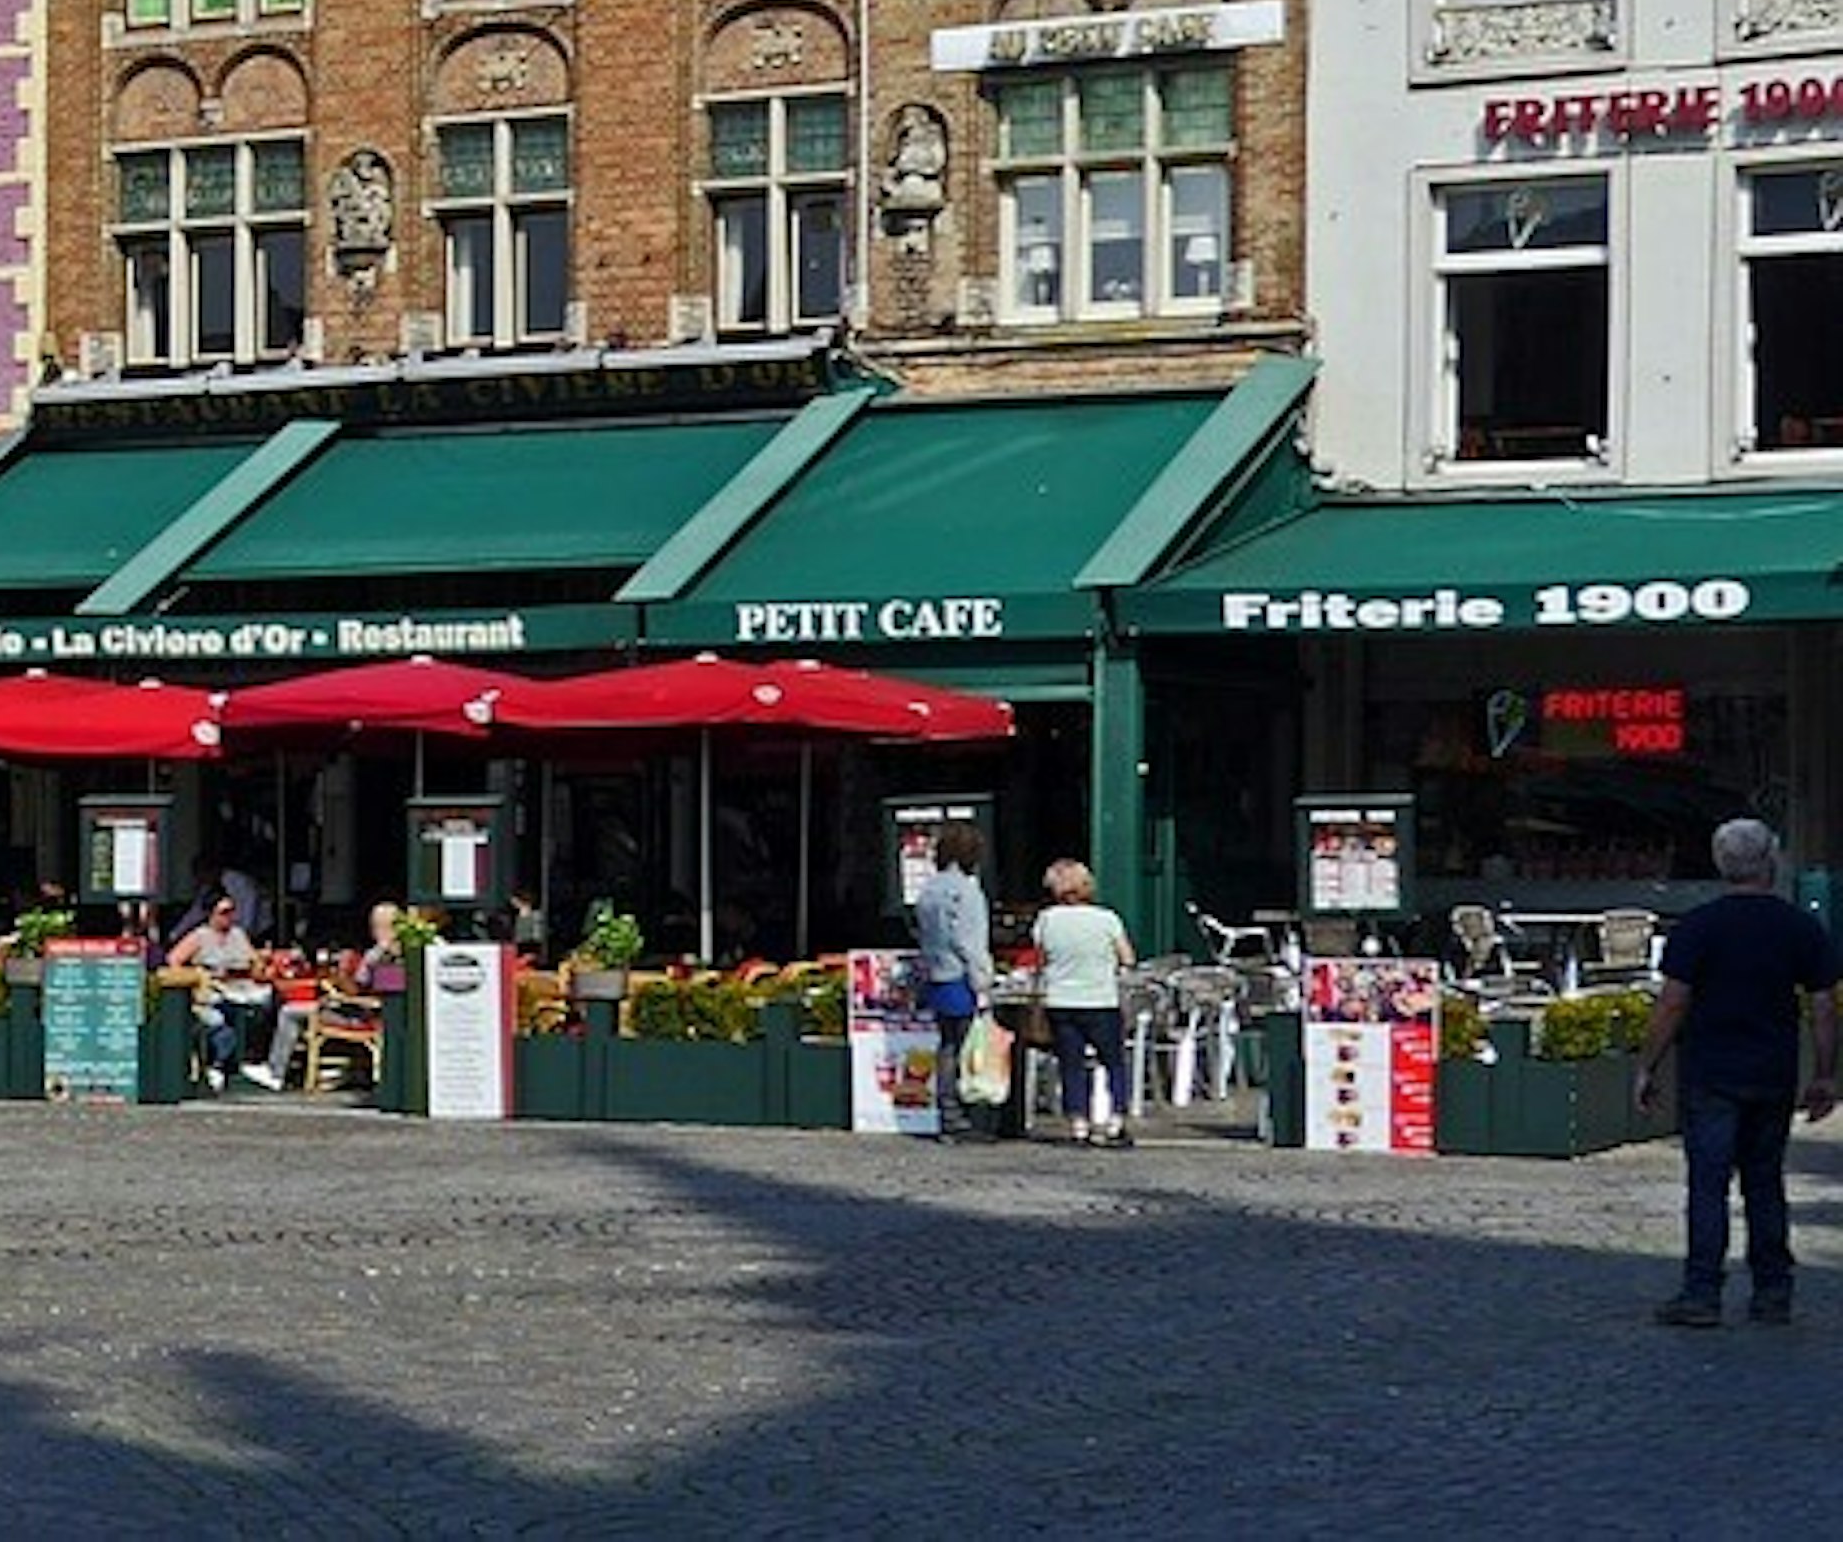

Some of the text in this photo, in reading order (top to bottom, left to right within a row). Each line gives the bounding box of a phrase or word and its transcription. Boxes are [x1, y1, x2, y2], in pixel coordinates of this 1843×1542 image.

[1484, 85, 1721, 142] FRITERIE
[734, 597, 1004, 642] PETIT CAFE
[1221, 579, 1751, 630] Friterie 1900
[52, 628, 95, 655] La
[230, 624, 305, 655] d'Or
[336, 612, 526, 653] Restaurant
[1544, 689, 1684, 718] FRITERIE
[1615, 722, 1682, 750] 1900
